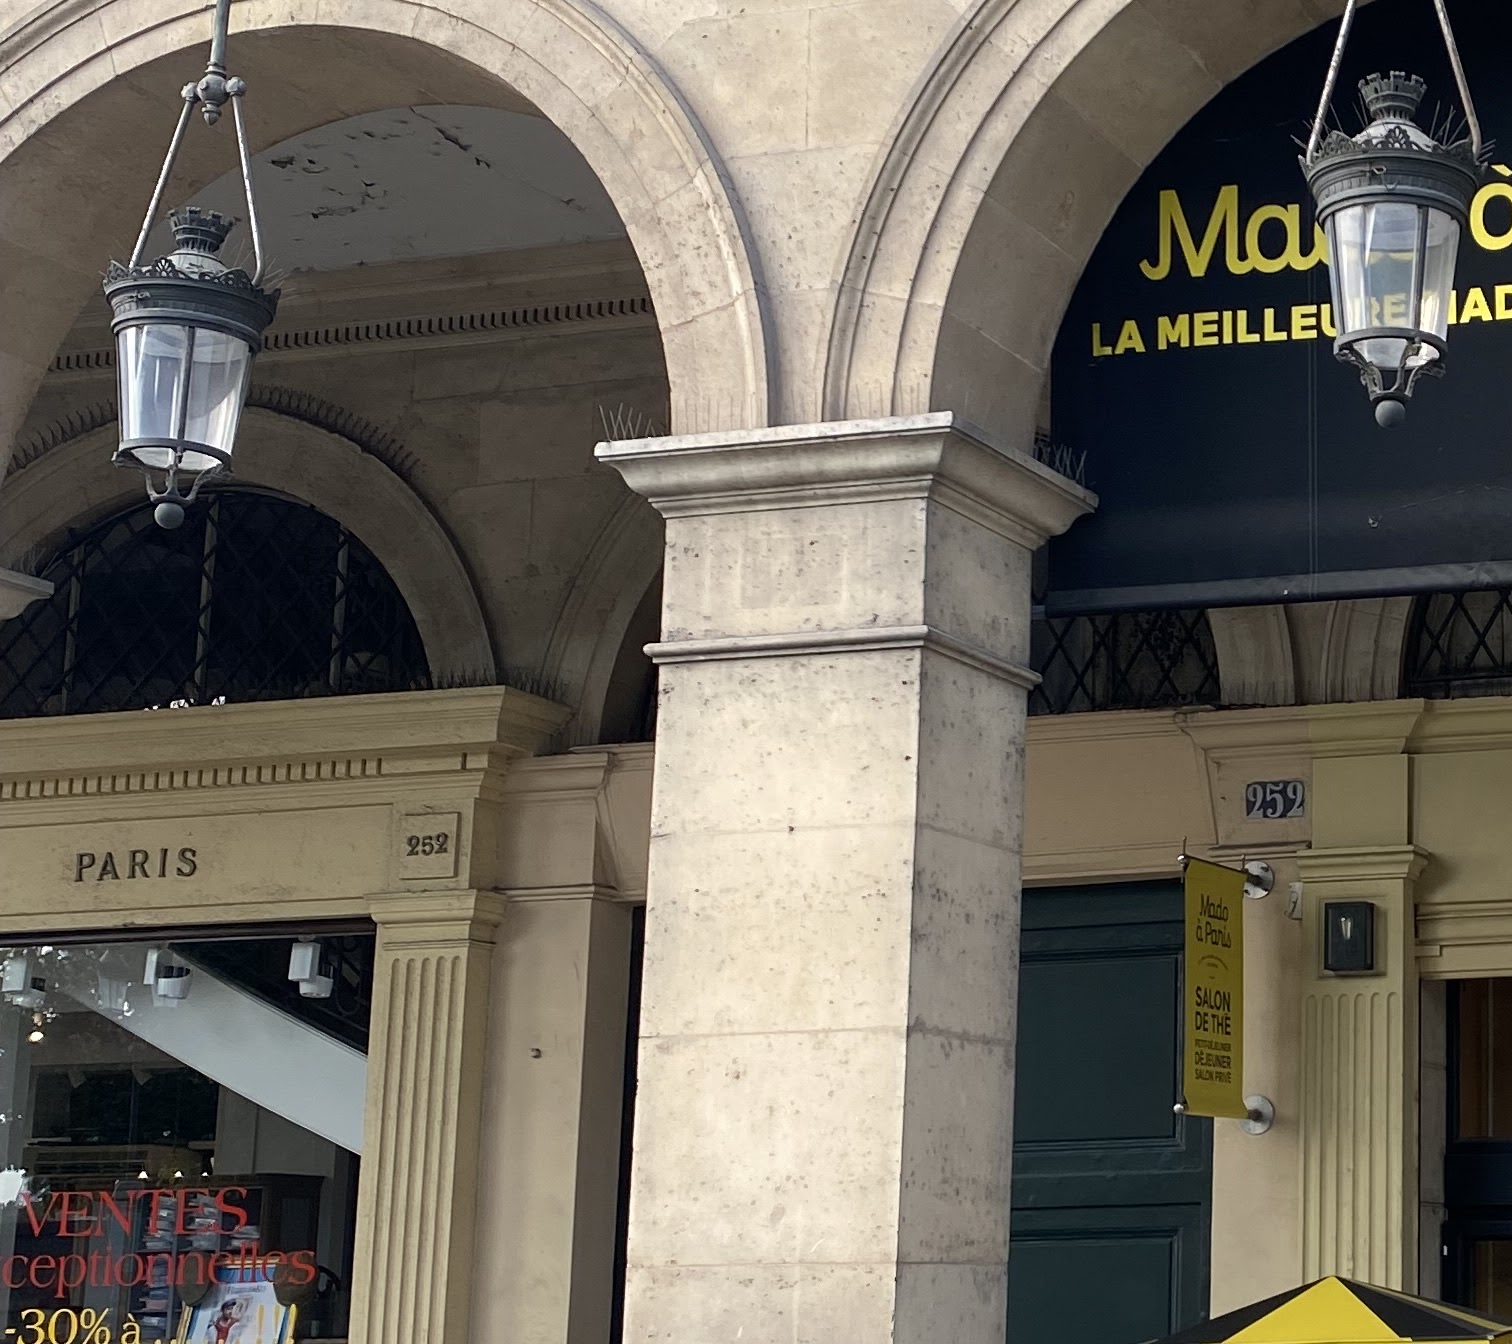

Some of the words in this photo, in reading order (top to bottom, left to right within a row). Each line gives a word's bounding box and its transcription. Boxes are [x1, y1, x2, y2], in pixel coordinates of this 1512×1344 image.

[1139, 184, 1330, 281] Ma
[1092, 320, 1146, 356] LA
[1247, 781, 1304, 818] 252
[406, 832, 449, 857] 252
[74, 847, 198, 882] PARIS
[1200, 893, 1229, 922] Mado
[1196, 918, 1203, 942] à
[1205, 921, 1231, 949] Paris
[1195, 985, 1231, 1013] SALON
[1195, 1011, 1209, 1032] DE
[19, 1186, 248, 1238] VENTES
